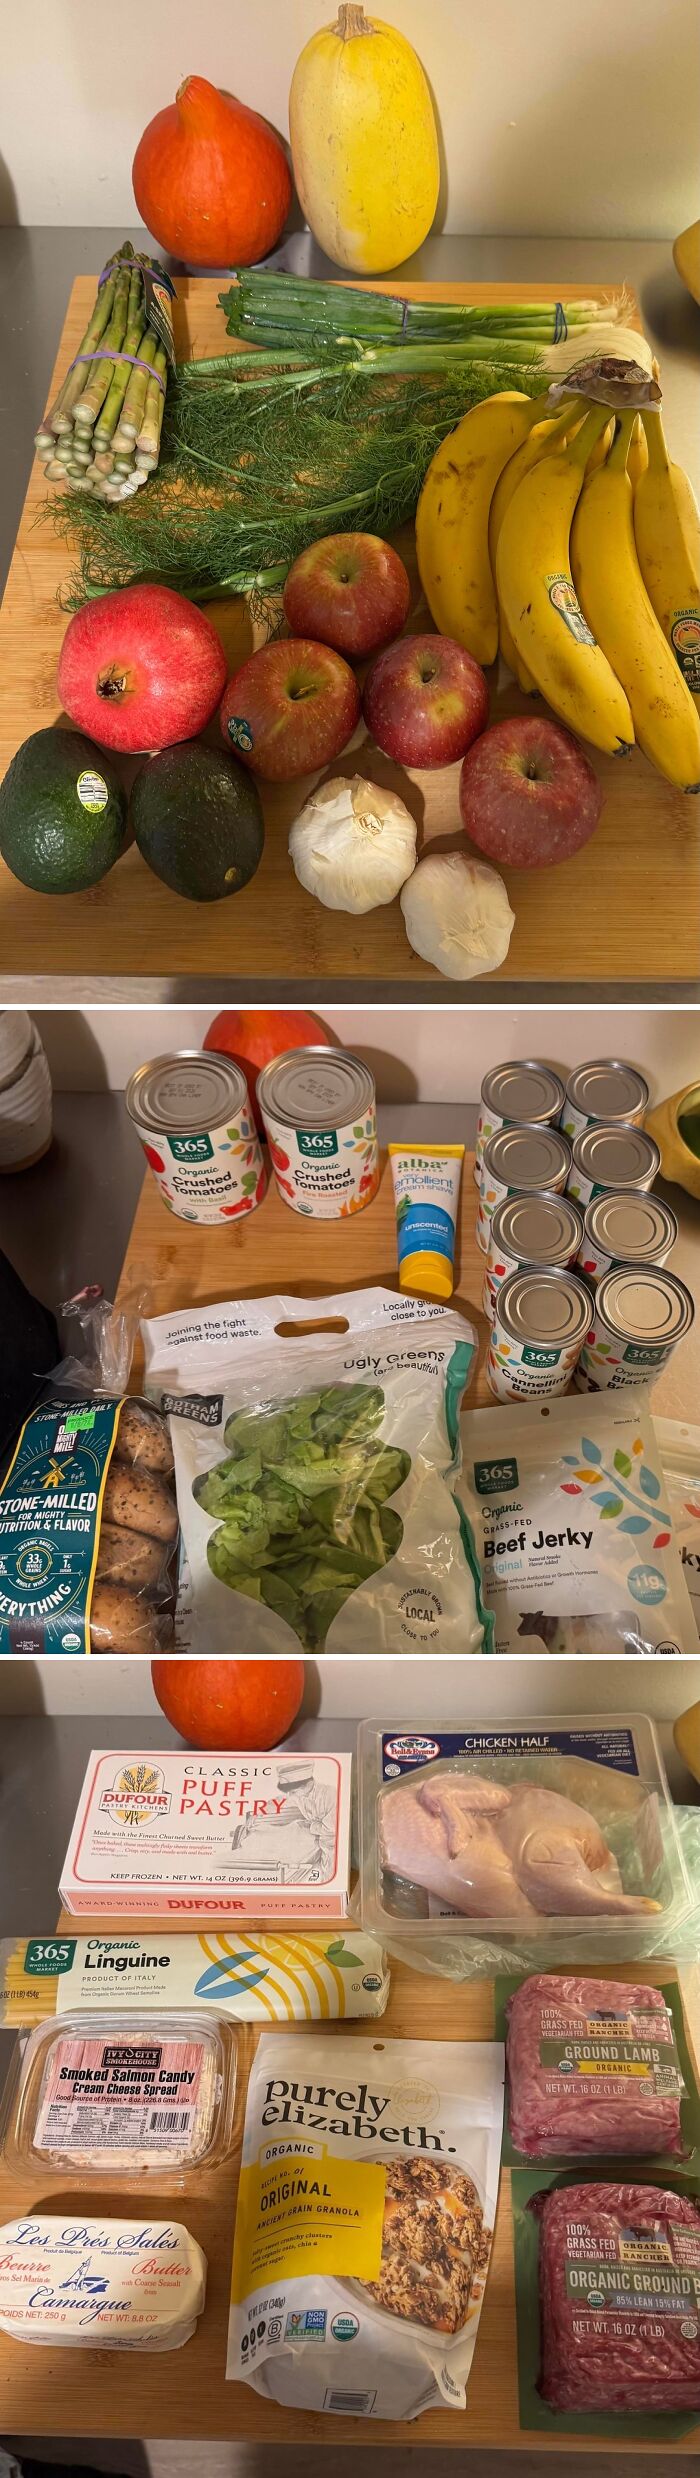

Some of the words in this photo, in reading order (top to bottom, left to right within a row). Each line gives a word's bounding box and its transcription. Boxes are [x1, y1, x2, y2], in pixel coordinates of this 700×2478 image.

[673, 609, 699, 617] ORGANIC
[173, 1138, 208, 1154] 365
[301, 1135, 334, 1148] 365
[301, 1161, 340, 1173] Organic
[397, 1158, 442, 1169] alba
[178, 1166, 219, 1177] Organic
[294, 1168, 351, 1182] Crushed
[172, 1171, 232, 1187] Crushed
[292, 1177, 356, 1192] Tomatoes
[394, 1176, 454, 1191] emollient
[171, 1180, 238, 1197] Tomatoes
[396, 1184, 425, 1195] cream
[426, 1184, 454, 1196] shave
[404, 1222, 449, 1232] unscented
[382, 1300, 415, 1312] Locally
[390, 1312, 415, 1321] close
[165, 1324, 202, 1339] Joining
[203, 1321, 221, 1330] the
[222, 1318, 247, 1329] fight
[205, 1331, 228, 1340] food
[230, 1328, 262, 1338] waste.
[343, 1355, 381, 1370] Ugly
[386, 1350, 446, 1364] Greens
[524, 1351, 557, 1361] 365
[627, 1349, 660, 1359] 365
[501, 1368, 567, 1387] Cannellini
[516, 1368, 556, 1380] Organic
[611, 1374, 650, 1385] Black
[511, 1383, 552, 1396] Beans
[90, 1403, 113, 1413] DAILY
[164, 1402, 218, 1423] GREENS
[165, 1397, 219, 1415] GOTHAM
[479, 1465, 513, 1482] 365
[18, 1512, 34, 1521] FOR
[34, 1511, 65, 1519] MIGHTY
[481, 1501, 524, 1520] Organic
[0, 1520, 41, 1534] UTRITION
[43, 1520, 51, 1531] &
[54, 1518, 91, 1533] FLAVOR
[483, 1518, 532, 1534] GRASS-FED
[17, 1540, 38, 1552] ORGANIC
[483, 1531, 526, 1558] Beef
[532, 1527, 593, 1550] Jerky
[483, 1558, 523, 1575] Original
[15, 1577, 31, 1588] WHOLE
[633, 1573, 660, 1590] 11g
[0, 1583, 71, 1617] VERYTHING
[405, 1606, 436, 1622] LOCAL
[400, 1623, 417, 1640] CLOSE
[429, 1628, 440, 1639] YOU
[464, 1737, 518, 1748] CHICKEN
[520, 1736, 550, 1747] HALF
[184, 1766, 272, 1777] CLASSIC
[182, 1779, 253, 1797] PUFF
[102, 1793, 168, 1806] DUFOUR
[179, 1798, 287, 1817] PASTRY
[110, 1872, 130, 1880] KEEP
[168, 1899, 246, 1910] DUFOUR
[30, 1943, 70, 1962] 365
[87, 1939, 141, 1953] Organic
[84, 1952, 171, 1972] Linguine
[26, 1990, 40, 2000] 454g
[540, 2009, 561, 2018] 100%
[540, 2020, 568, 2030] GRASS
[568, 2020, 583, 2029] FED
[106, 2049, 126, 2058] IVY
[134, 2050, 160, 2059] CITY
[564, 2046, 619, 2060] GROUND
[623, 2047, 660, 2062] LAMB
[595, 2063, 632, 2072] ORGANIC
[59, 2067, 110, 2081] Smoked
[112, 2069, 156, 2082] Salmon
[158, 2070, 196, 2084] Candy
[72, 2082, 105, 2094] Cream
[106, 2083, 141, 2095] Cheese
[143, 2084, 178, 2097] Spread
[545, 2083, 561, 2094] NET
[561, 2083, 578, 2094] WT.
[580, 2084, 589, 2094] 16
[591, 2084, 601, 2094] OZ
[612, 2084, 626, 2095] LB)
[263, 2079, 391, 2122] purely
[265, 2143, 315, 2160] ORGANIC
[260, 2179, 332, 2212] ORIGINAL
[256, 2212, 286, 2231] ANCIENT
[287, 2204, 313, 2217] GRAIN
[316, 2205, 360, 2217] GRANOLA
[565, 2223, 591, 2236] 100%
[7, 2223, 51, 2246] Les
[55, 2226, 111, 2247] Prés
[117, 2227, 180, 2250] Salés
[280, 2233, 305, 2244] crunchy
[566, 2237, 597, 2249] GRASS
[599, 2238, 616, 2250] FED
[623, 2242, 668, 2251] ORGANIC
[567, 2250, 605, 2259] VEGETARIAN
[605, 2250, 617, 2260] FED
[622, 2252, 670, 2261] RANCHER
[0, 2252, 51, 2272] Beurre
[132, 2256, 193, 2276] Butter
[11, 2274, 23, 2282] Sel
[24, 2275, 43, 2283] Marin
[134, 2278, 158, 2287] Coarse
[569, 2270, 631, 2290] ORGANIC
[633, 2274, 691, 2294] GROUND
[29, 2286, 132, 2326] Camargue
[616, 2295, 633, 2306] 85%
[633, 2296, 653, 2307] LEAN
[655, 2298, 671, 2308] 15%
[672, 2299, 685, 2309] FAT
[0, 2310, 24, 2318] POIDS
[25, 2310, 43, 2319] NET:
[44, 2311, 60, 2319] 250
[97, 2314, 116, 2322] NET
[117, 2314, 130, 2322] WT:
[132, 2314, 144, 2322] 8.8
[337, 2319, 354, 2327] USDA
[572, 2320, 591, 2333] NET
[592, 2321, 610, 2334] WT.
[612, 2322, 621, 2335] 16
[624, 2323, 636, 2336] OZ
[650, 2324, 665, 2337] LB)
